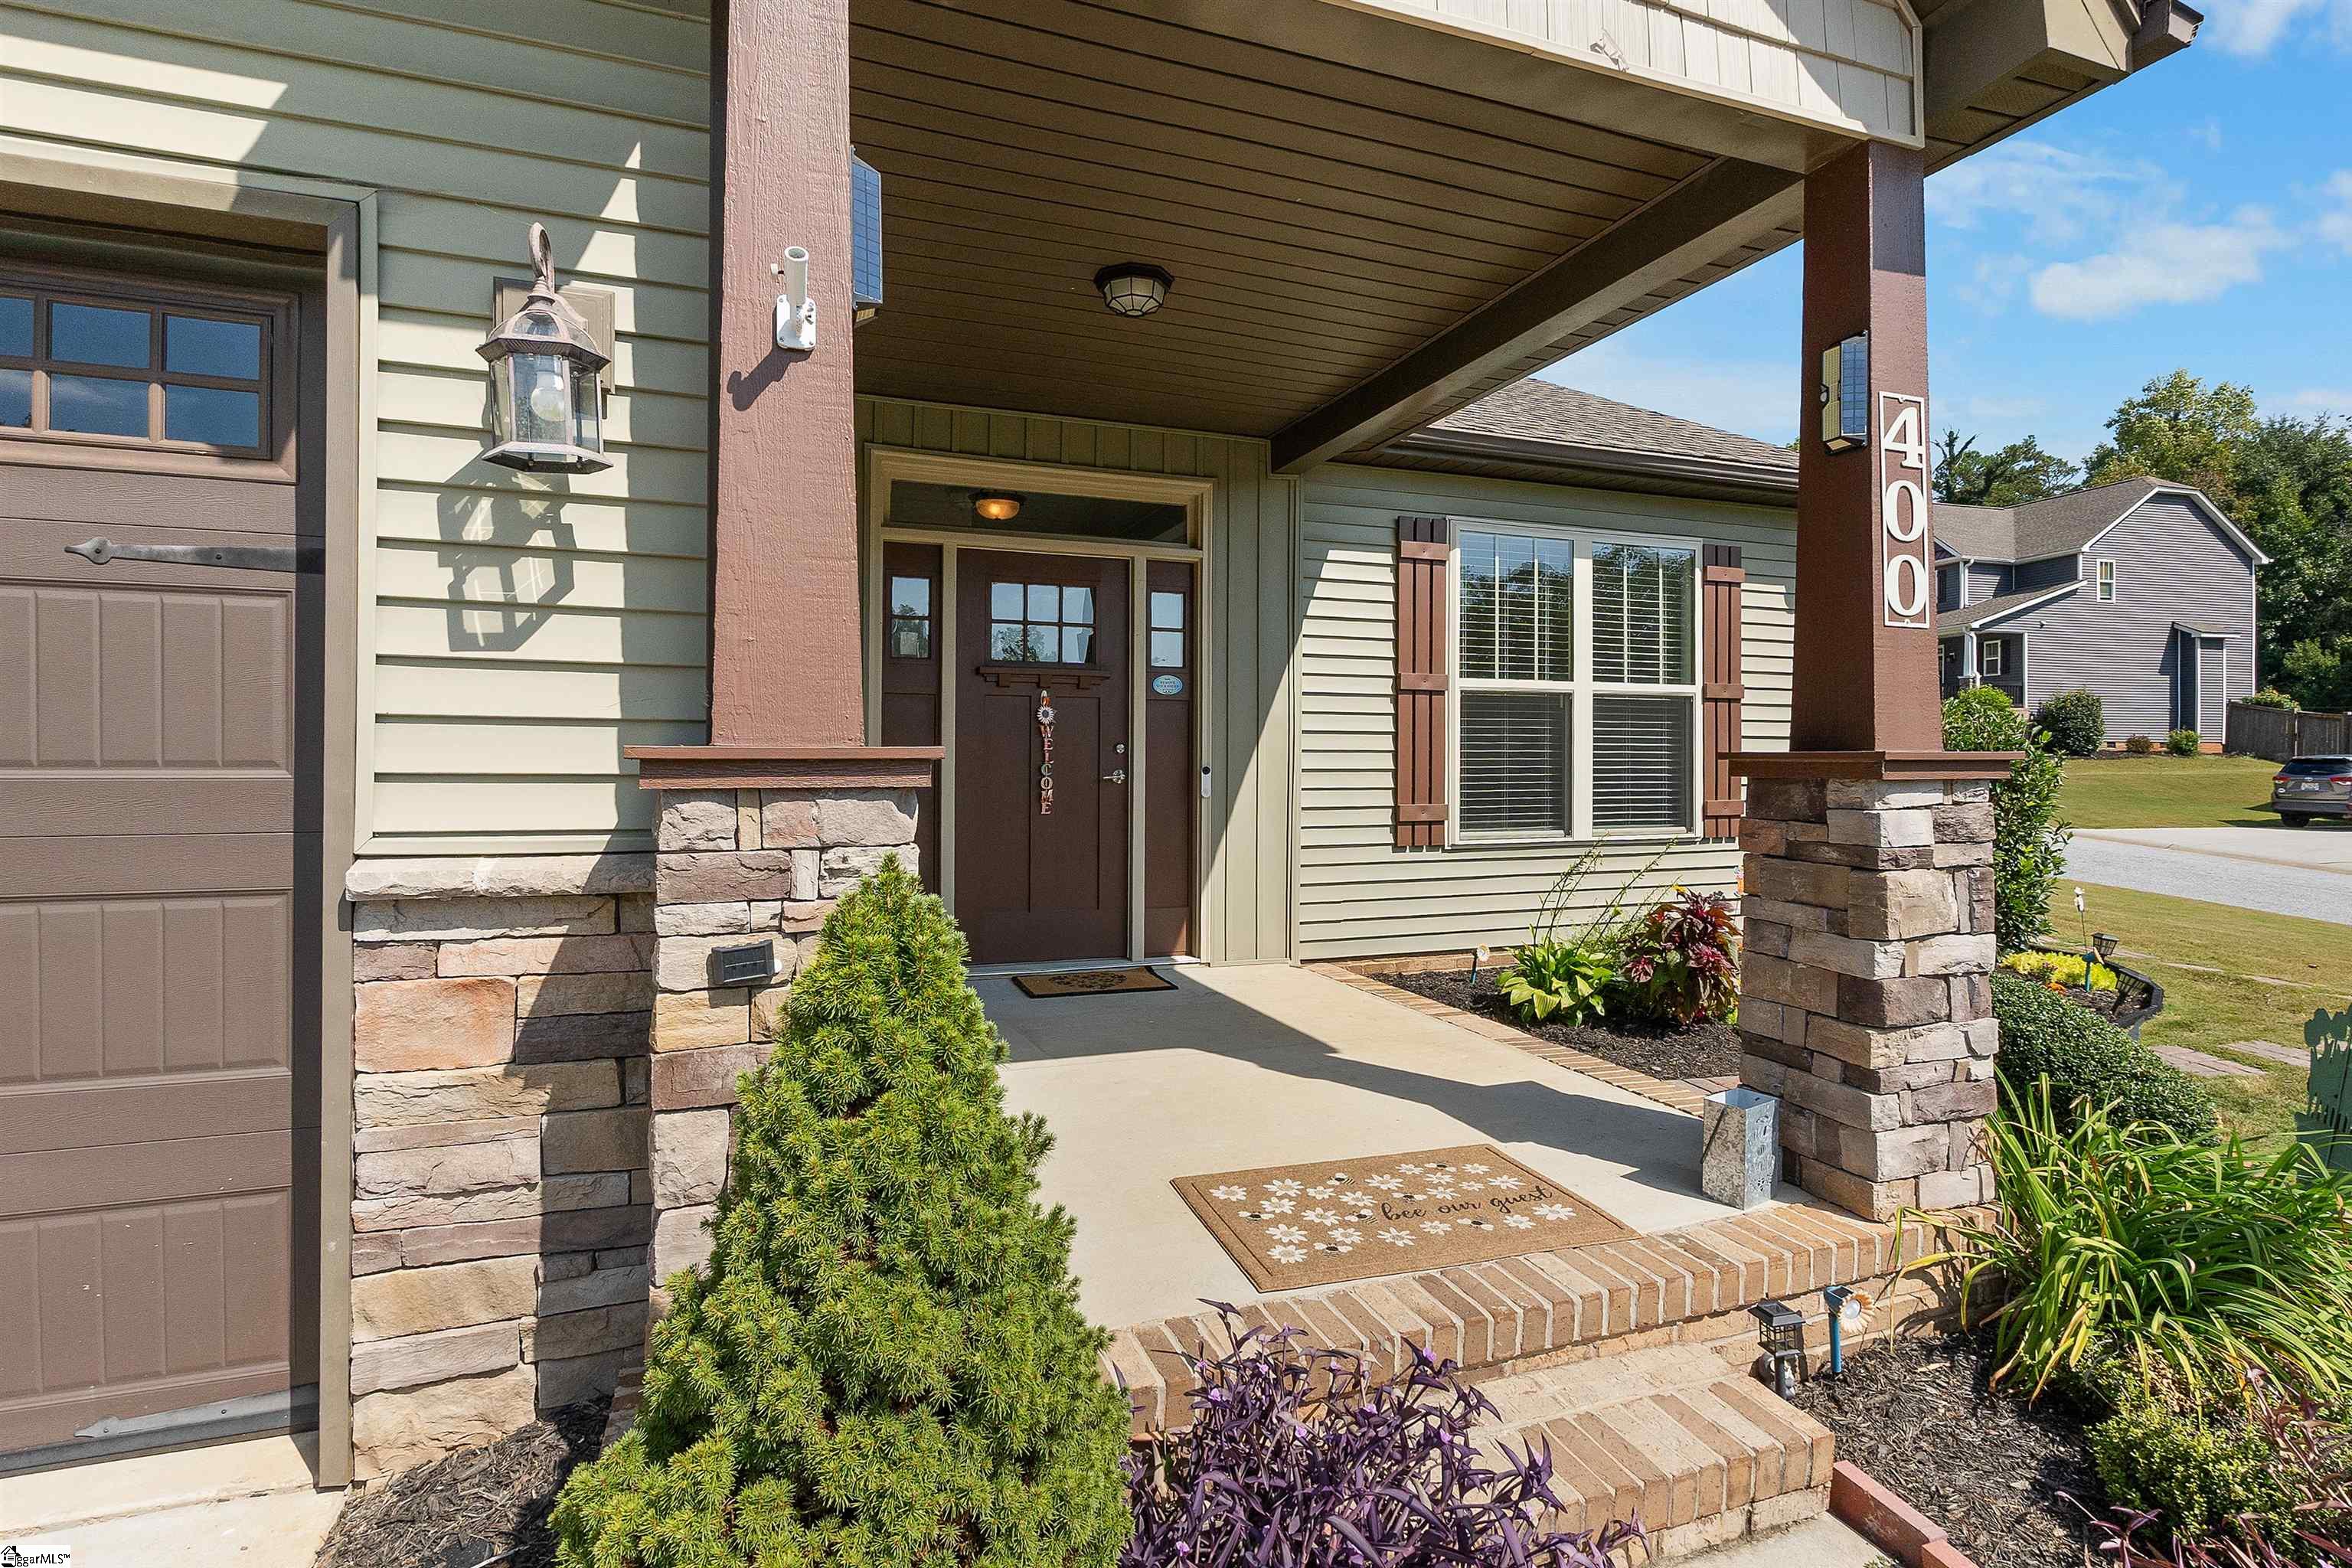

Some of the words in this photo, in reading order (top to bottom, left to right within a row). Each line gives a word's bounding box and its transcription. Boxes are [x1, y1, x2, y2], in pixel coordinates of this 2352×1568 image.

[1883, 407, 1927, 617] 400
[1040, 724, 1054, 815] WELCOME
[1381, 1201, 1427, 1220] bee
[1438, 1201, 1481, 1214] our
[1490, 1184, 1553, 1214] guest
